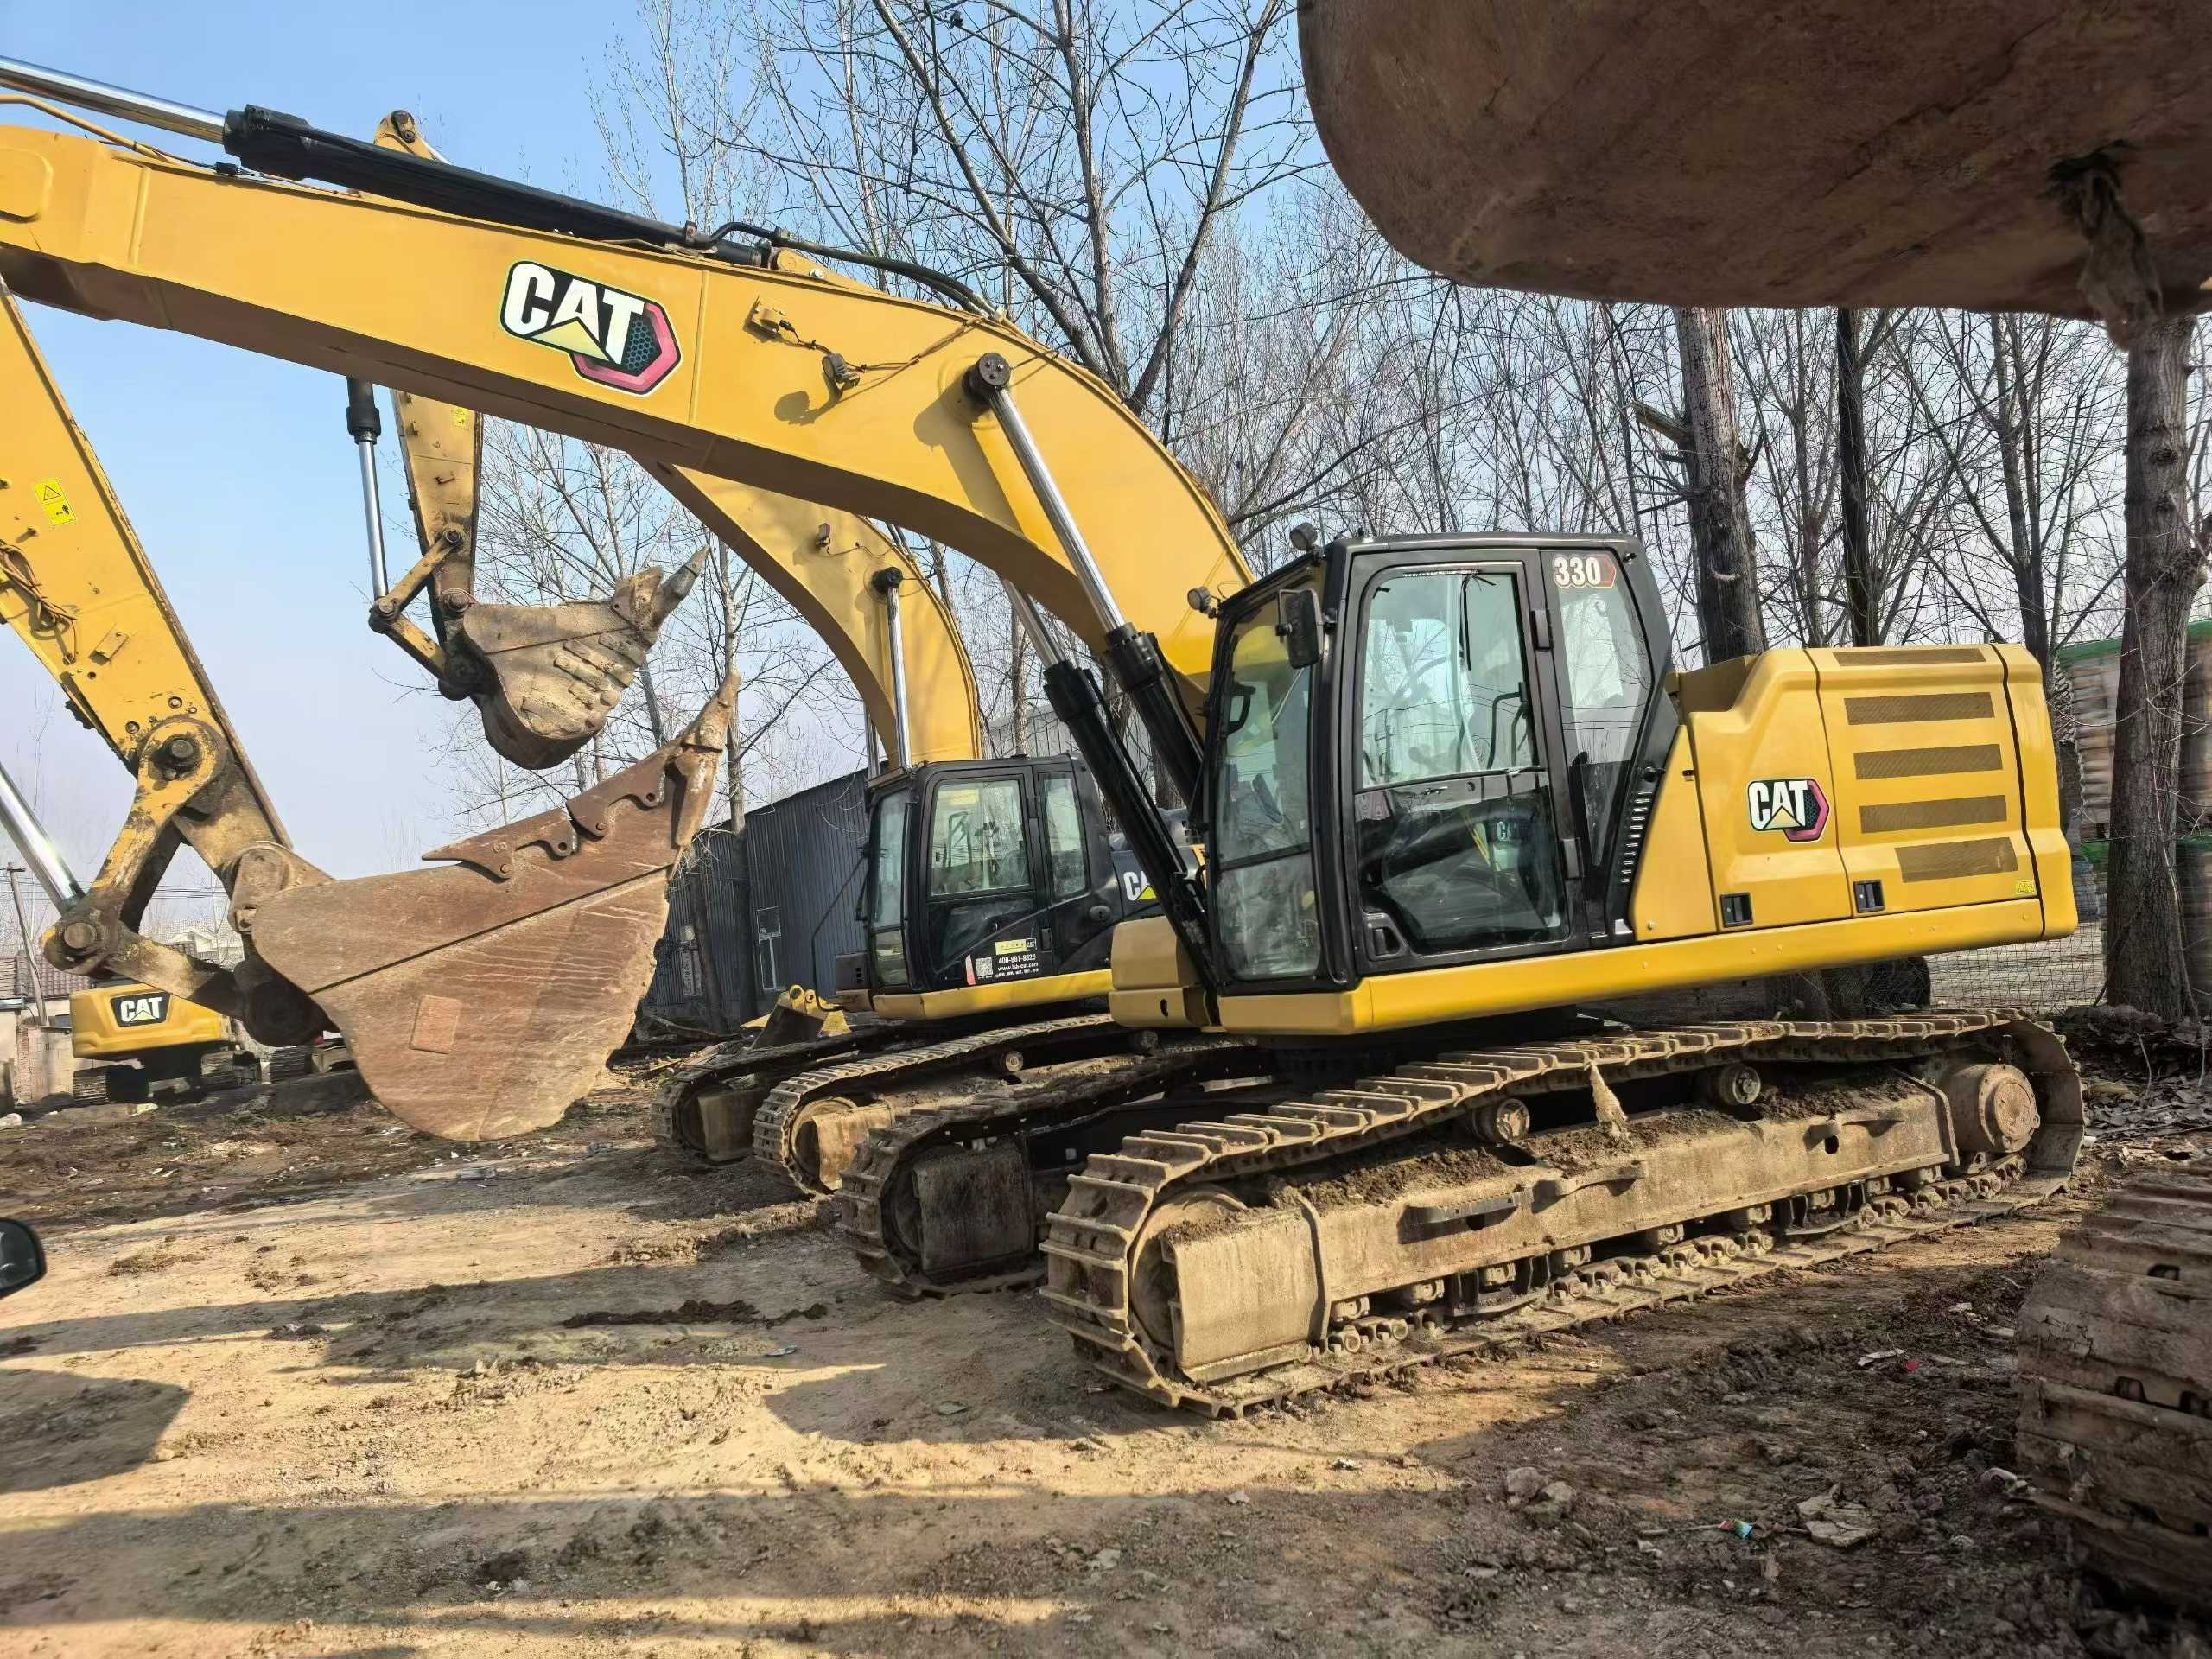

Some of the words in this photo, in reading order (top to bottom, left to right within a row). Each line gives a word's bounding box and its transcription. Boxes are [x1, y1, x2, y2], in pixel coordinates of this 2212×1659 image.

[504, 263, 645, 365] CAT
[1554, 556, 1602, 586] 330
[1749, 780, 1808, 830] CAT
[120, 997, 162, 1022] CAT
